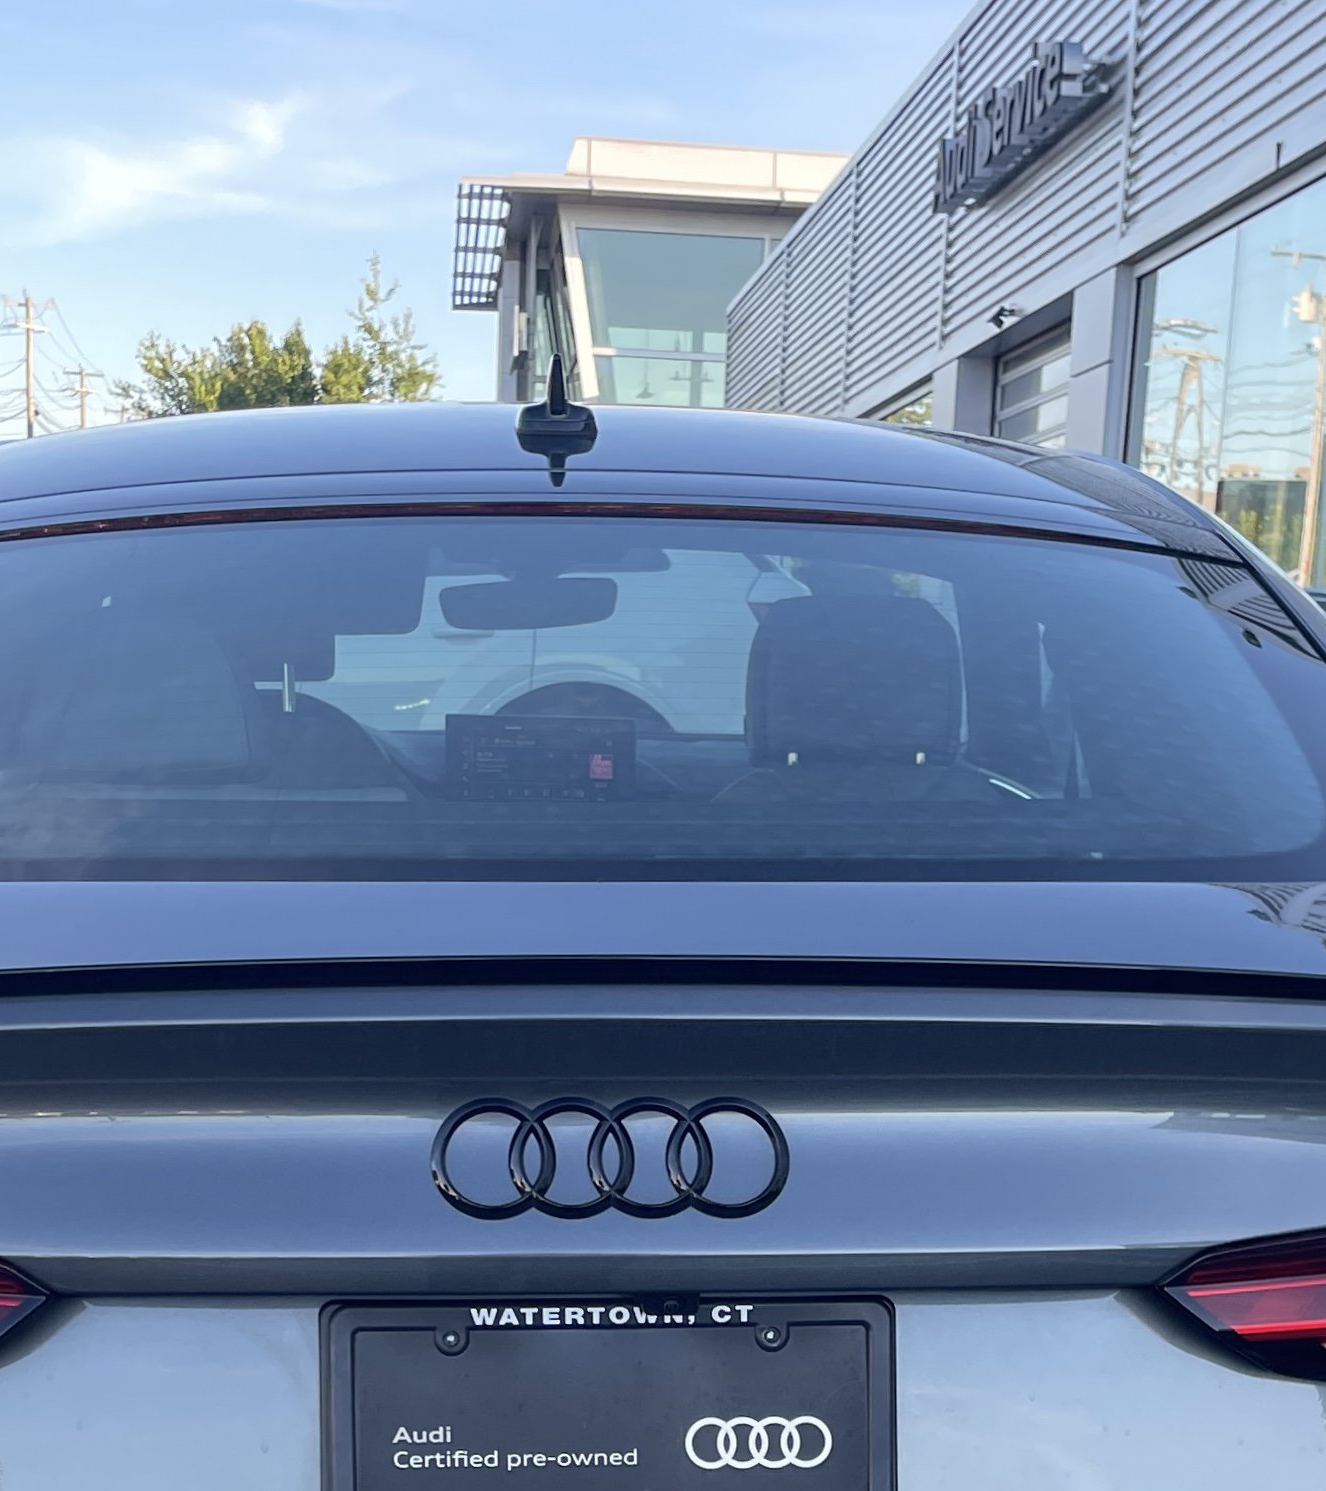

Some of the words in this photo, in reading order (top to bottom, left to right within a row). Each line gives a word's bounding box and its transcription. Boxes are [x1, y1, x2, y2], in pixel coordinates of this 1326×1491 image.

[711, 1304, 754, 1324] CT
[392, 1426, 452, 1444] Audi
[393, 1450, 499, 1469] Certified
[506, 1448, 638, 1471] pre-owned
